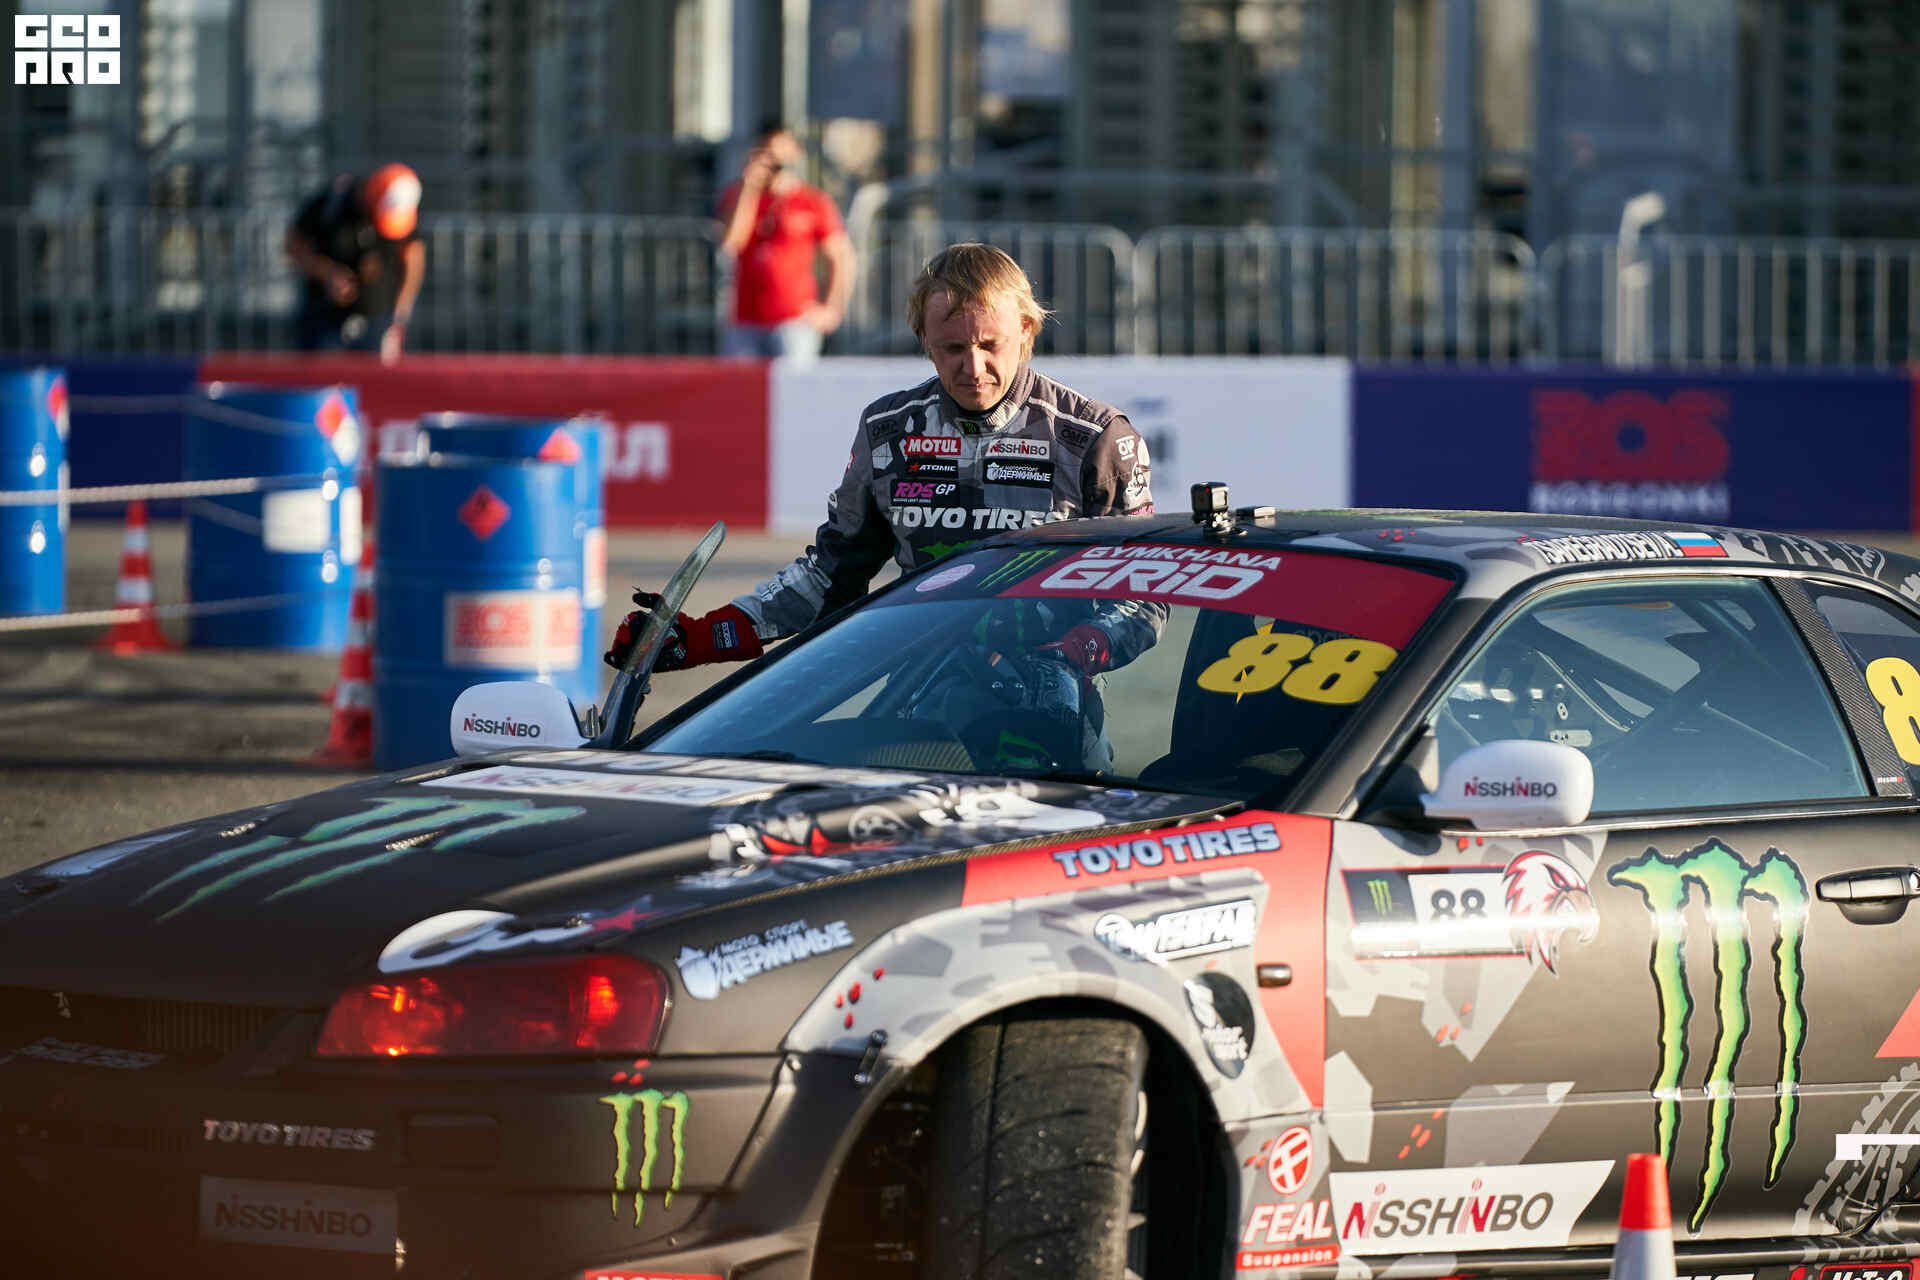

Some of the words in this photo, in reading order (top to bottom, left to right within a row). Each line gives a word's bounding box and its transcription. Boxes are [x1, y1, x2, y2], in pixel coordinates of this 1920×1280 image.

[908, 439, 958, 453] MOTUL
[990, 440, 1048, 455] NiSSHiNBO
[919, 464, 957, 472] ATOMIC
[895, 482, 937, 498] RDS
[936, 484, 956, 496] GP
[889, 506, 967, 529] TOYO
[1082, 545, 1283, 571] GYMKHANA
[1197, 632, 1398, 704] 88
[463, 713, 541, 738] NiSSHiNBO
[1464, 777, 1557, 797] NiSSHiNBO
[1053, 838, 1164, 878] TOYO
[1162, 823, 1281, 863] TIRES
[1431, 888, 1487, 921] 88
[203, 1120, 280, 1145] TOYO
[283, 1124, 377, 1150] TIRES
[214, 1193, 371, 1238] NiSSHiNBO
[1343, 1178, 1554, 1240] NiSSHiNBO
[1241, 1199, 1333, 1246] FEAL
[1241, 1248, 1333, 1268] Suspension
